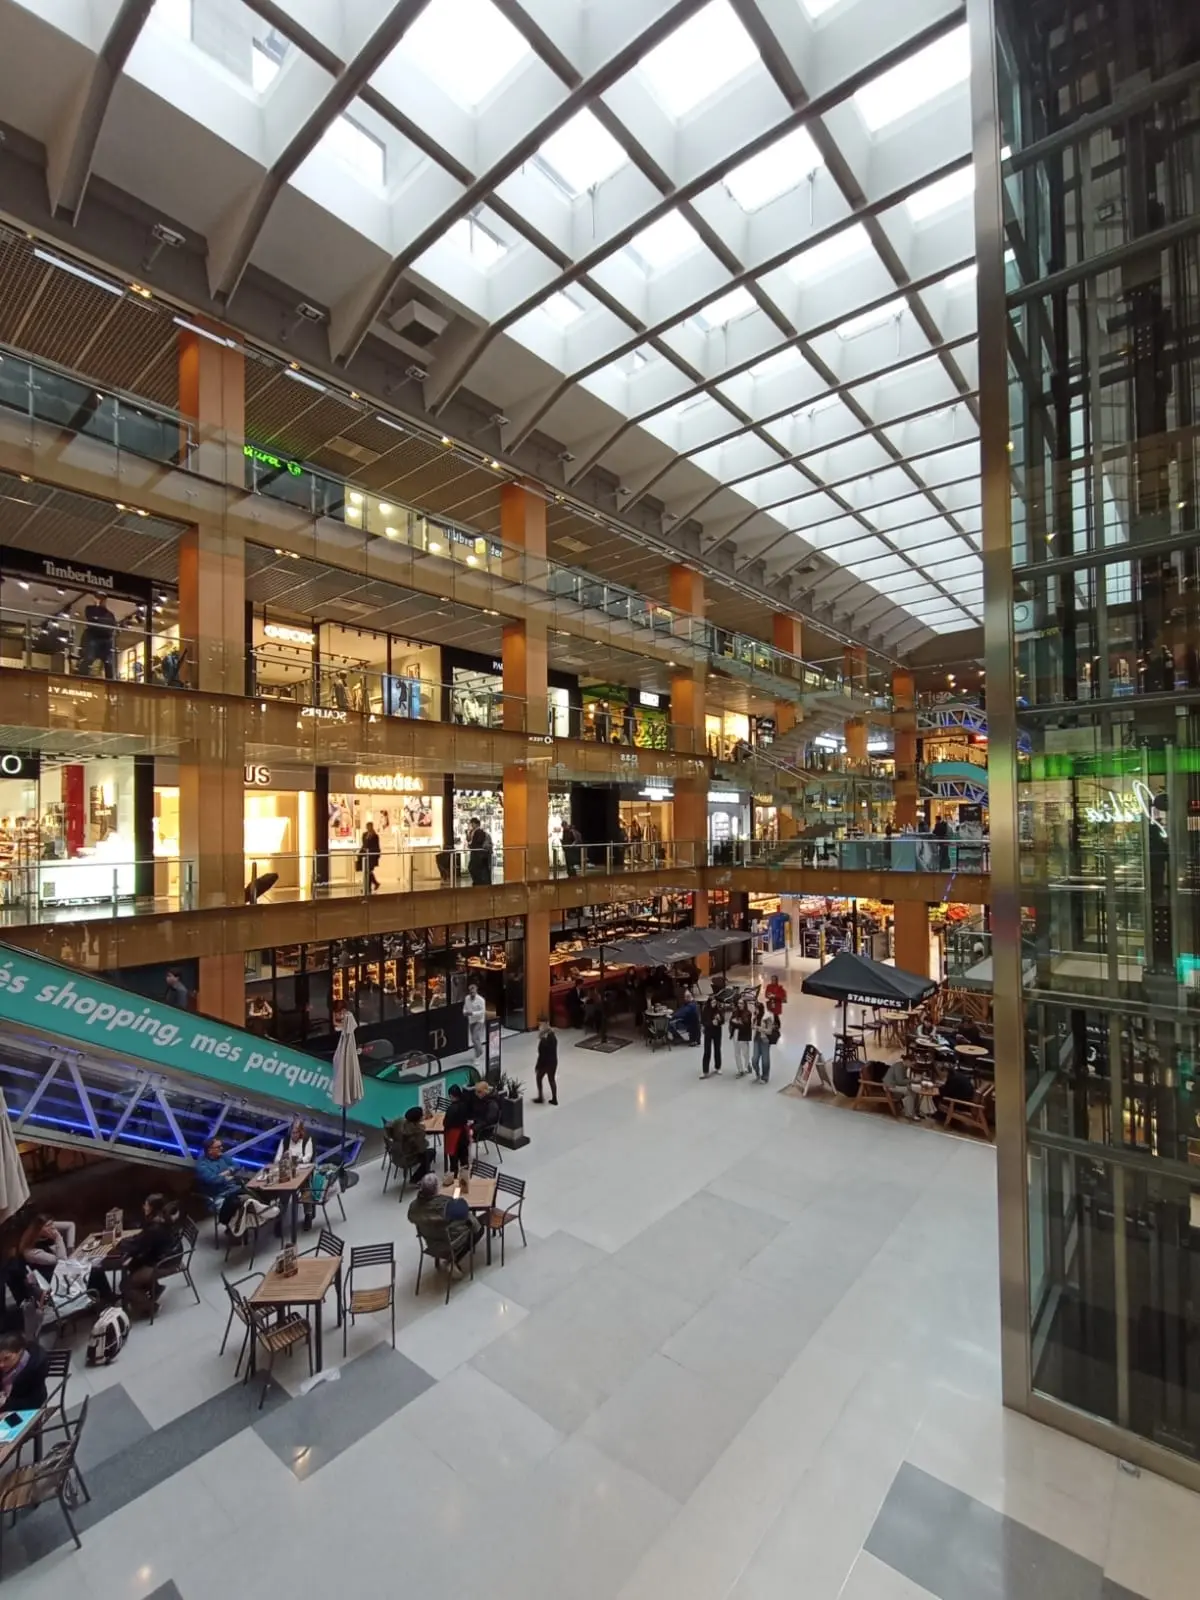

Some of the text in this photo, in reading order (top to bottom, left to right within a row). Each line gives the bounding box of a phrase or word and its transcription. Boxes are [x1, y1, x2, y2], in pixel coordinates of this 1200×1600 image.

[42, 560, 114, 589] Timberland
[0, 961, 30, 993] és
[34, 980, 183, 1047] shopping,
[190, 1033, 243, 1062] més
[846, 993, 902, 1008] STARBUCKS
